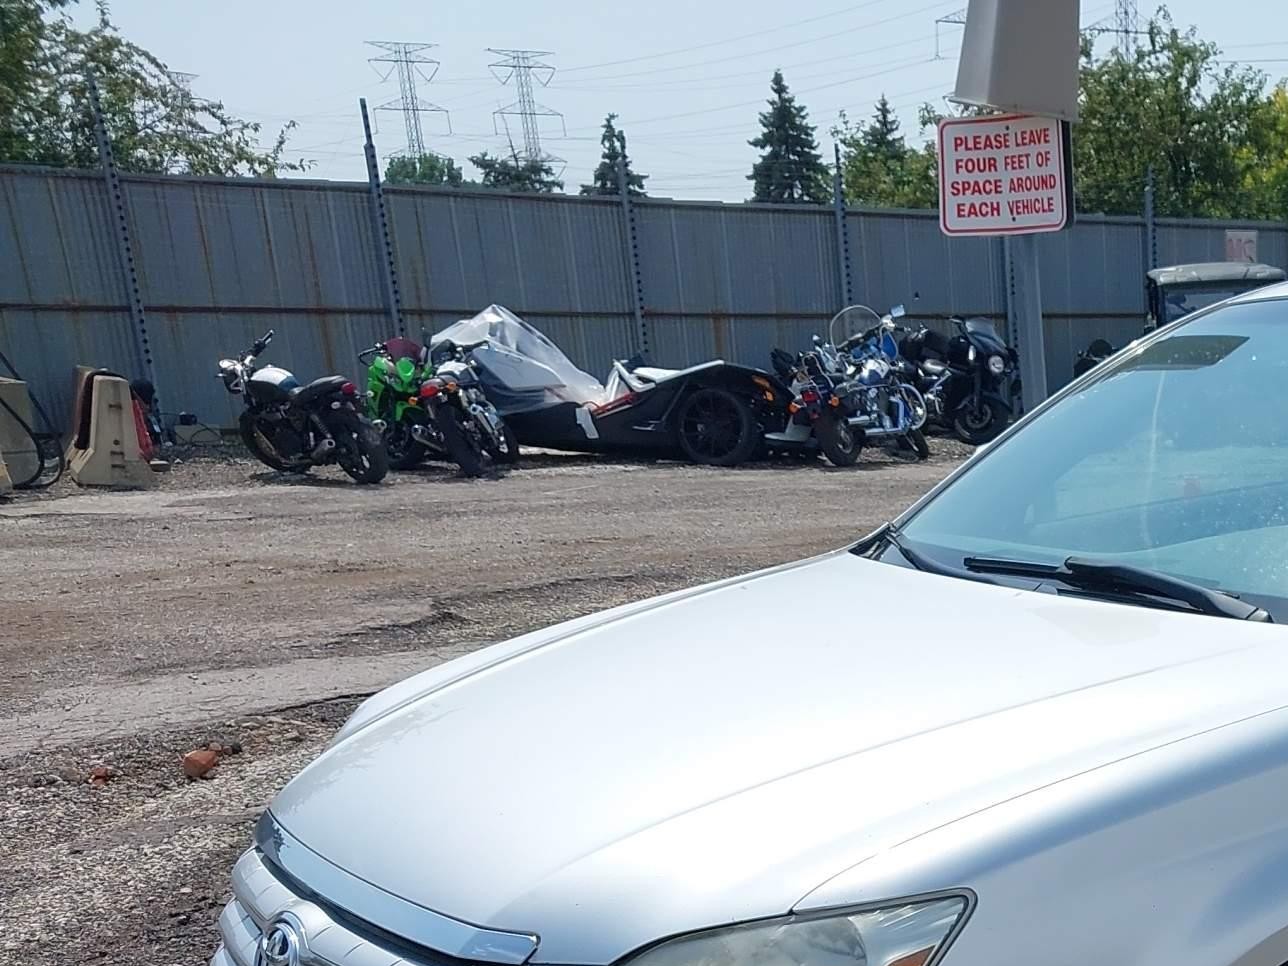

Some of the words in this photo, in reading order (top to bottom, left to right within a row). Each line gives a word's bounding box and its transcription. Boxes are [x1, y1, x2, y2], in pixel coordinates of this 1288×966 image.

[954, 133, 1010, 152] PLEASE
[1014, 128, 1050, 147] LEAVE
[955, 157, 997, 174] FOUR
[1004, 153, 1031, 171] FEET
[1036, 151, 1051, 167] OF
[951, 179, 1003, 196] SPACE
[1008, 174, 1057, 193] AROUND
[956, 202, 1001, 218] EACH
[1007, 197, 1054, 216] VEHICLE
